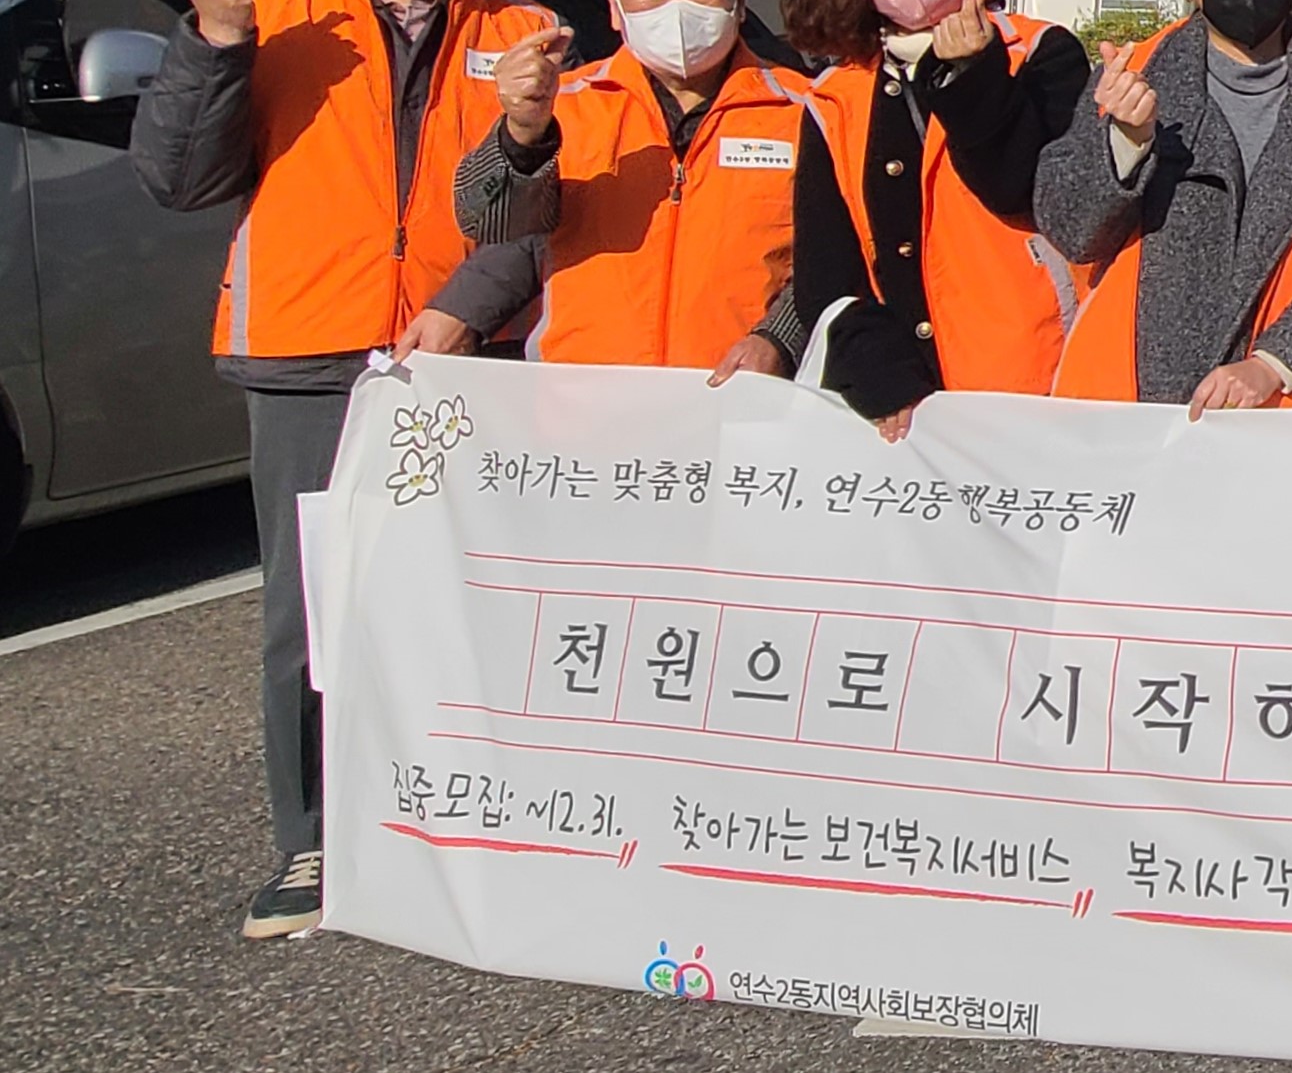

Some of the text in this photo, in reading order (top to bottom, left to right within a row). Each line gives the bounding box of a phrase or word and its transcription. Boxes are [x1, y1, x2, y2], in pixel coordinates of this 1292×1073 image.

[476, 449, 1137, 537] 찾아가는 맞춤형 복지, 연수2동행복공동체
[552, 620, 891, 713] 천원으로
[672, 794, 809, 863] 찾아가는
[728, 969, 1041, 1038] 연수2동지역사회보장협의체
